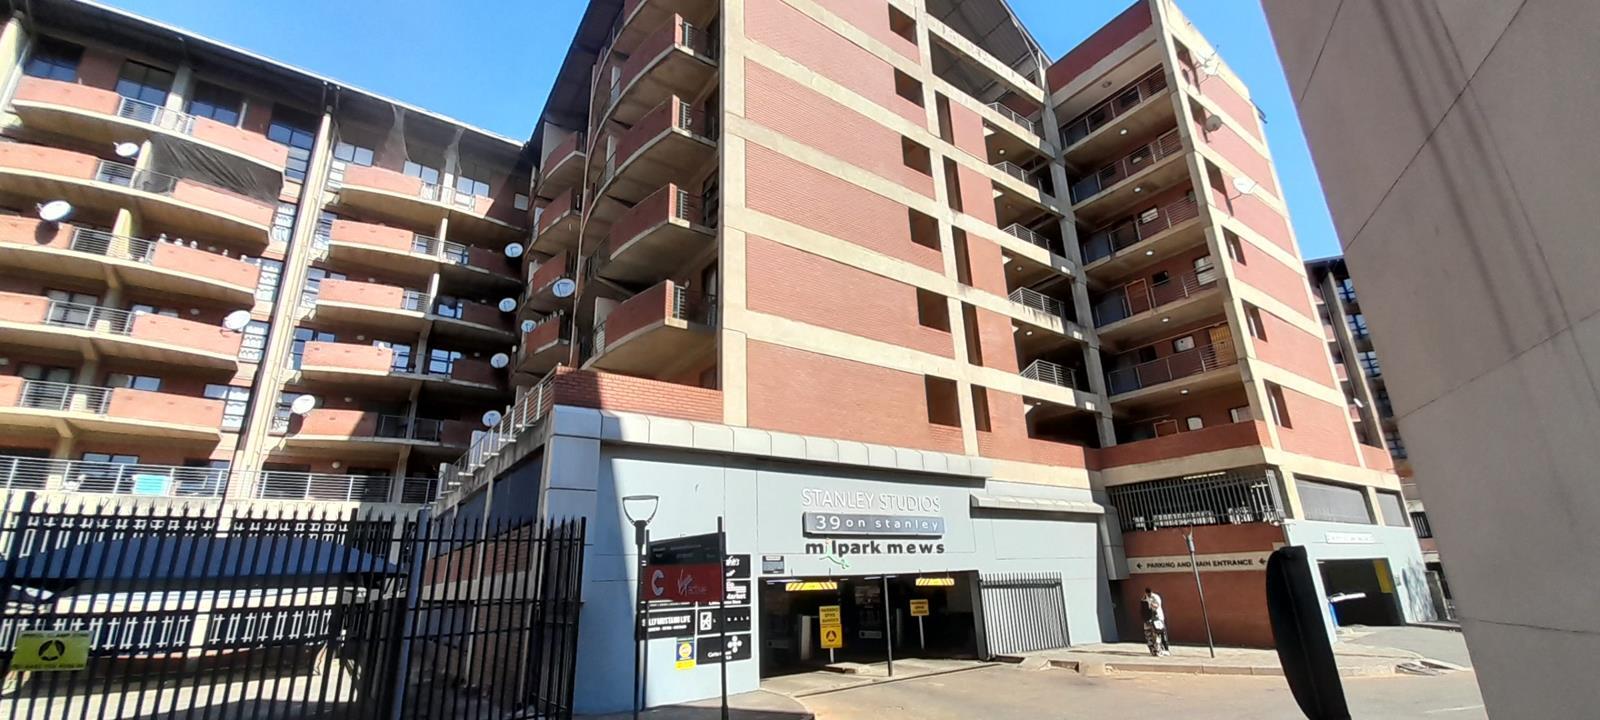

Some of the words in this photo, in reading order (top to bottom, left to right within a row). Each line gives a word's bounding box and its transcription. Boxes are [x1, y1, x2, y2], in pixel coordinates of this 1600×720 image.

[802, 488, 875, 510] STANLEY
[879, 493, 941, 513] STUDIOS
[815, 515, 841, 530] 39
[845, 519, 866, 528] on
[875, 519, 938, 531] stanley
[805, 539, 882, 557] milpark
[887, 542, 945, 554] mews
[1146, 561, 1176, 569] PARKING
[1213, 558, 1254, 567] ENTRANCE
